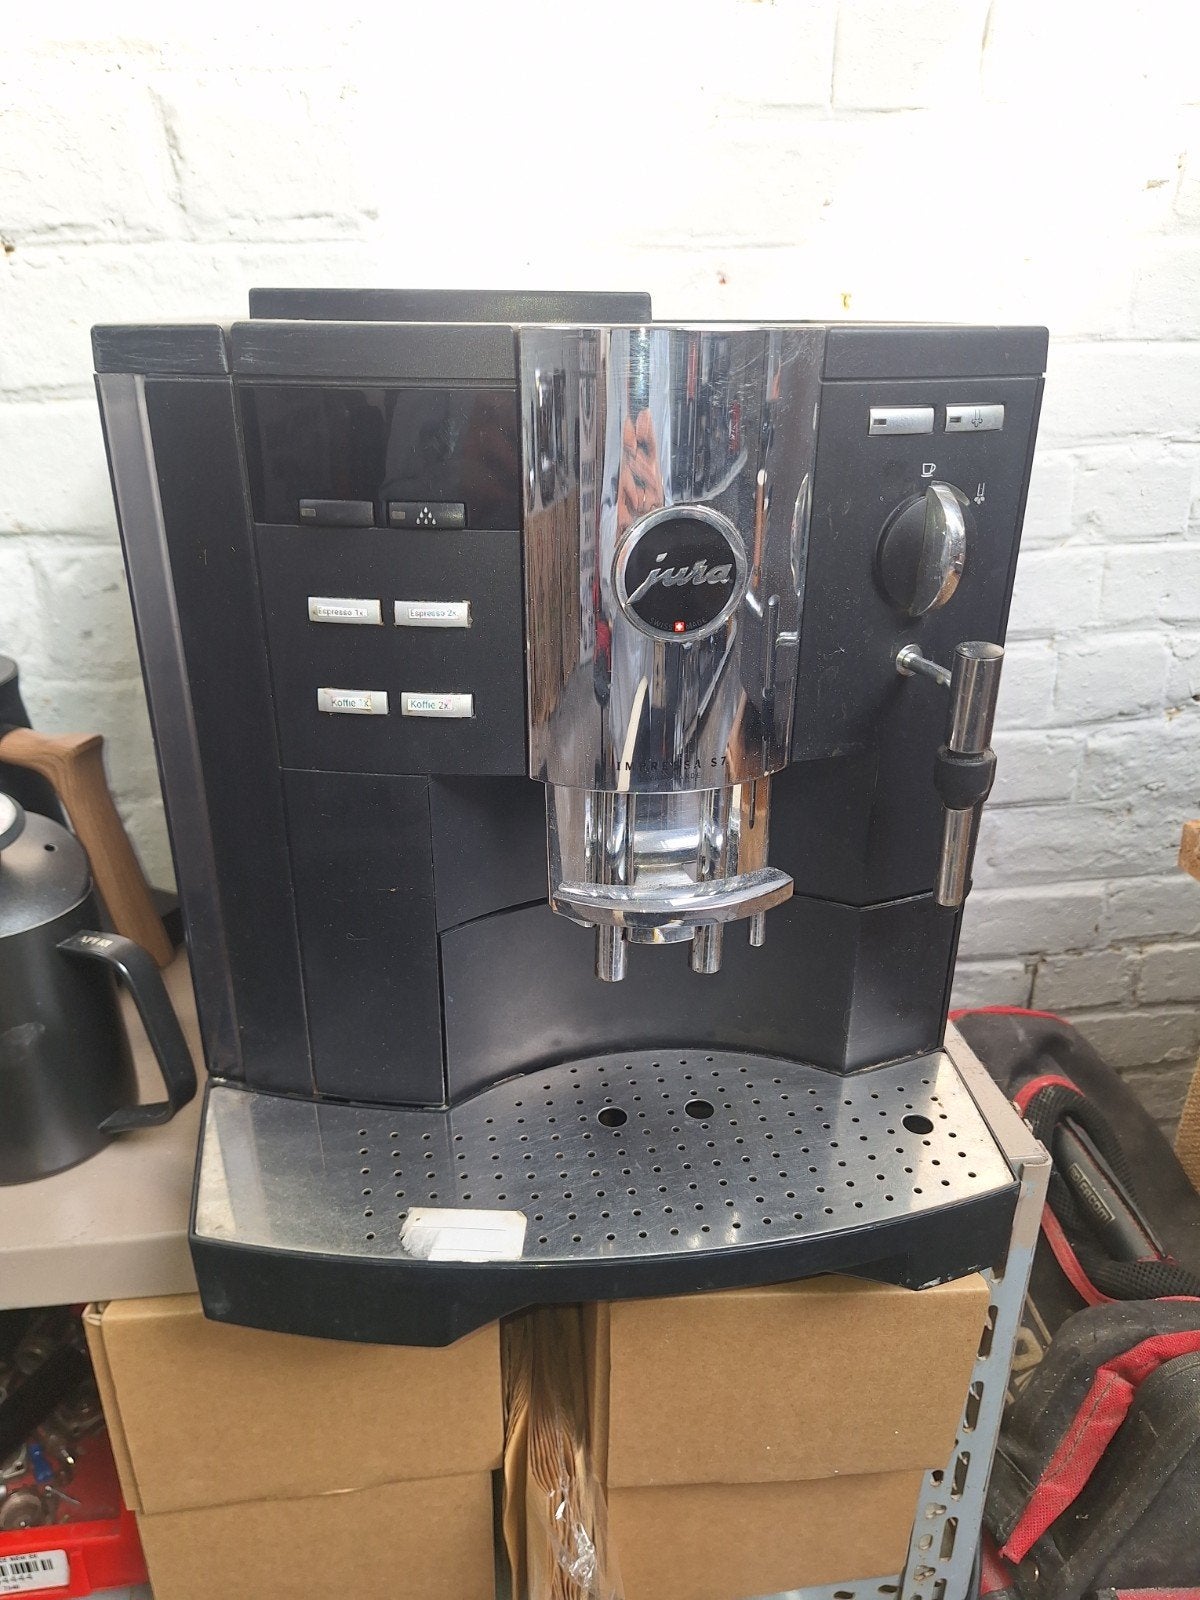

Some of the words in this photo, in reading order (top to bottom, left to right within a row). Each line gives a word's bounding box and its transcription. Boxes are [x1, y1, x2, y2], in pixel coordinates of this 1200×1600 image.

[626, 552, 733, 605] jura
[410, 609, 445, 618] Espresso
[447, 609, 458, 617] 2x
[650, 617, 673, 630] SWISS
[685, 616, 707, 630] MADE
[331, 698, 356, 707] Koffie
[410, 700, 436, 710] Koffie
[438, 701, 450, 710] 2x
[616, 760, 702, 772] IMPRESSA
[711, 756, 727, 768] S7
